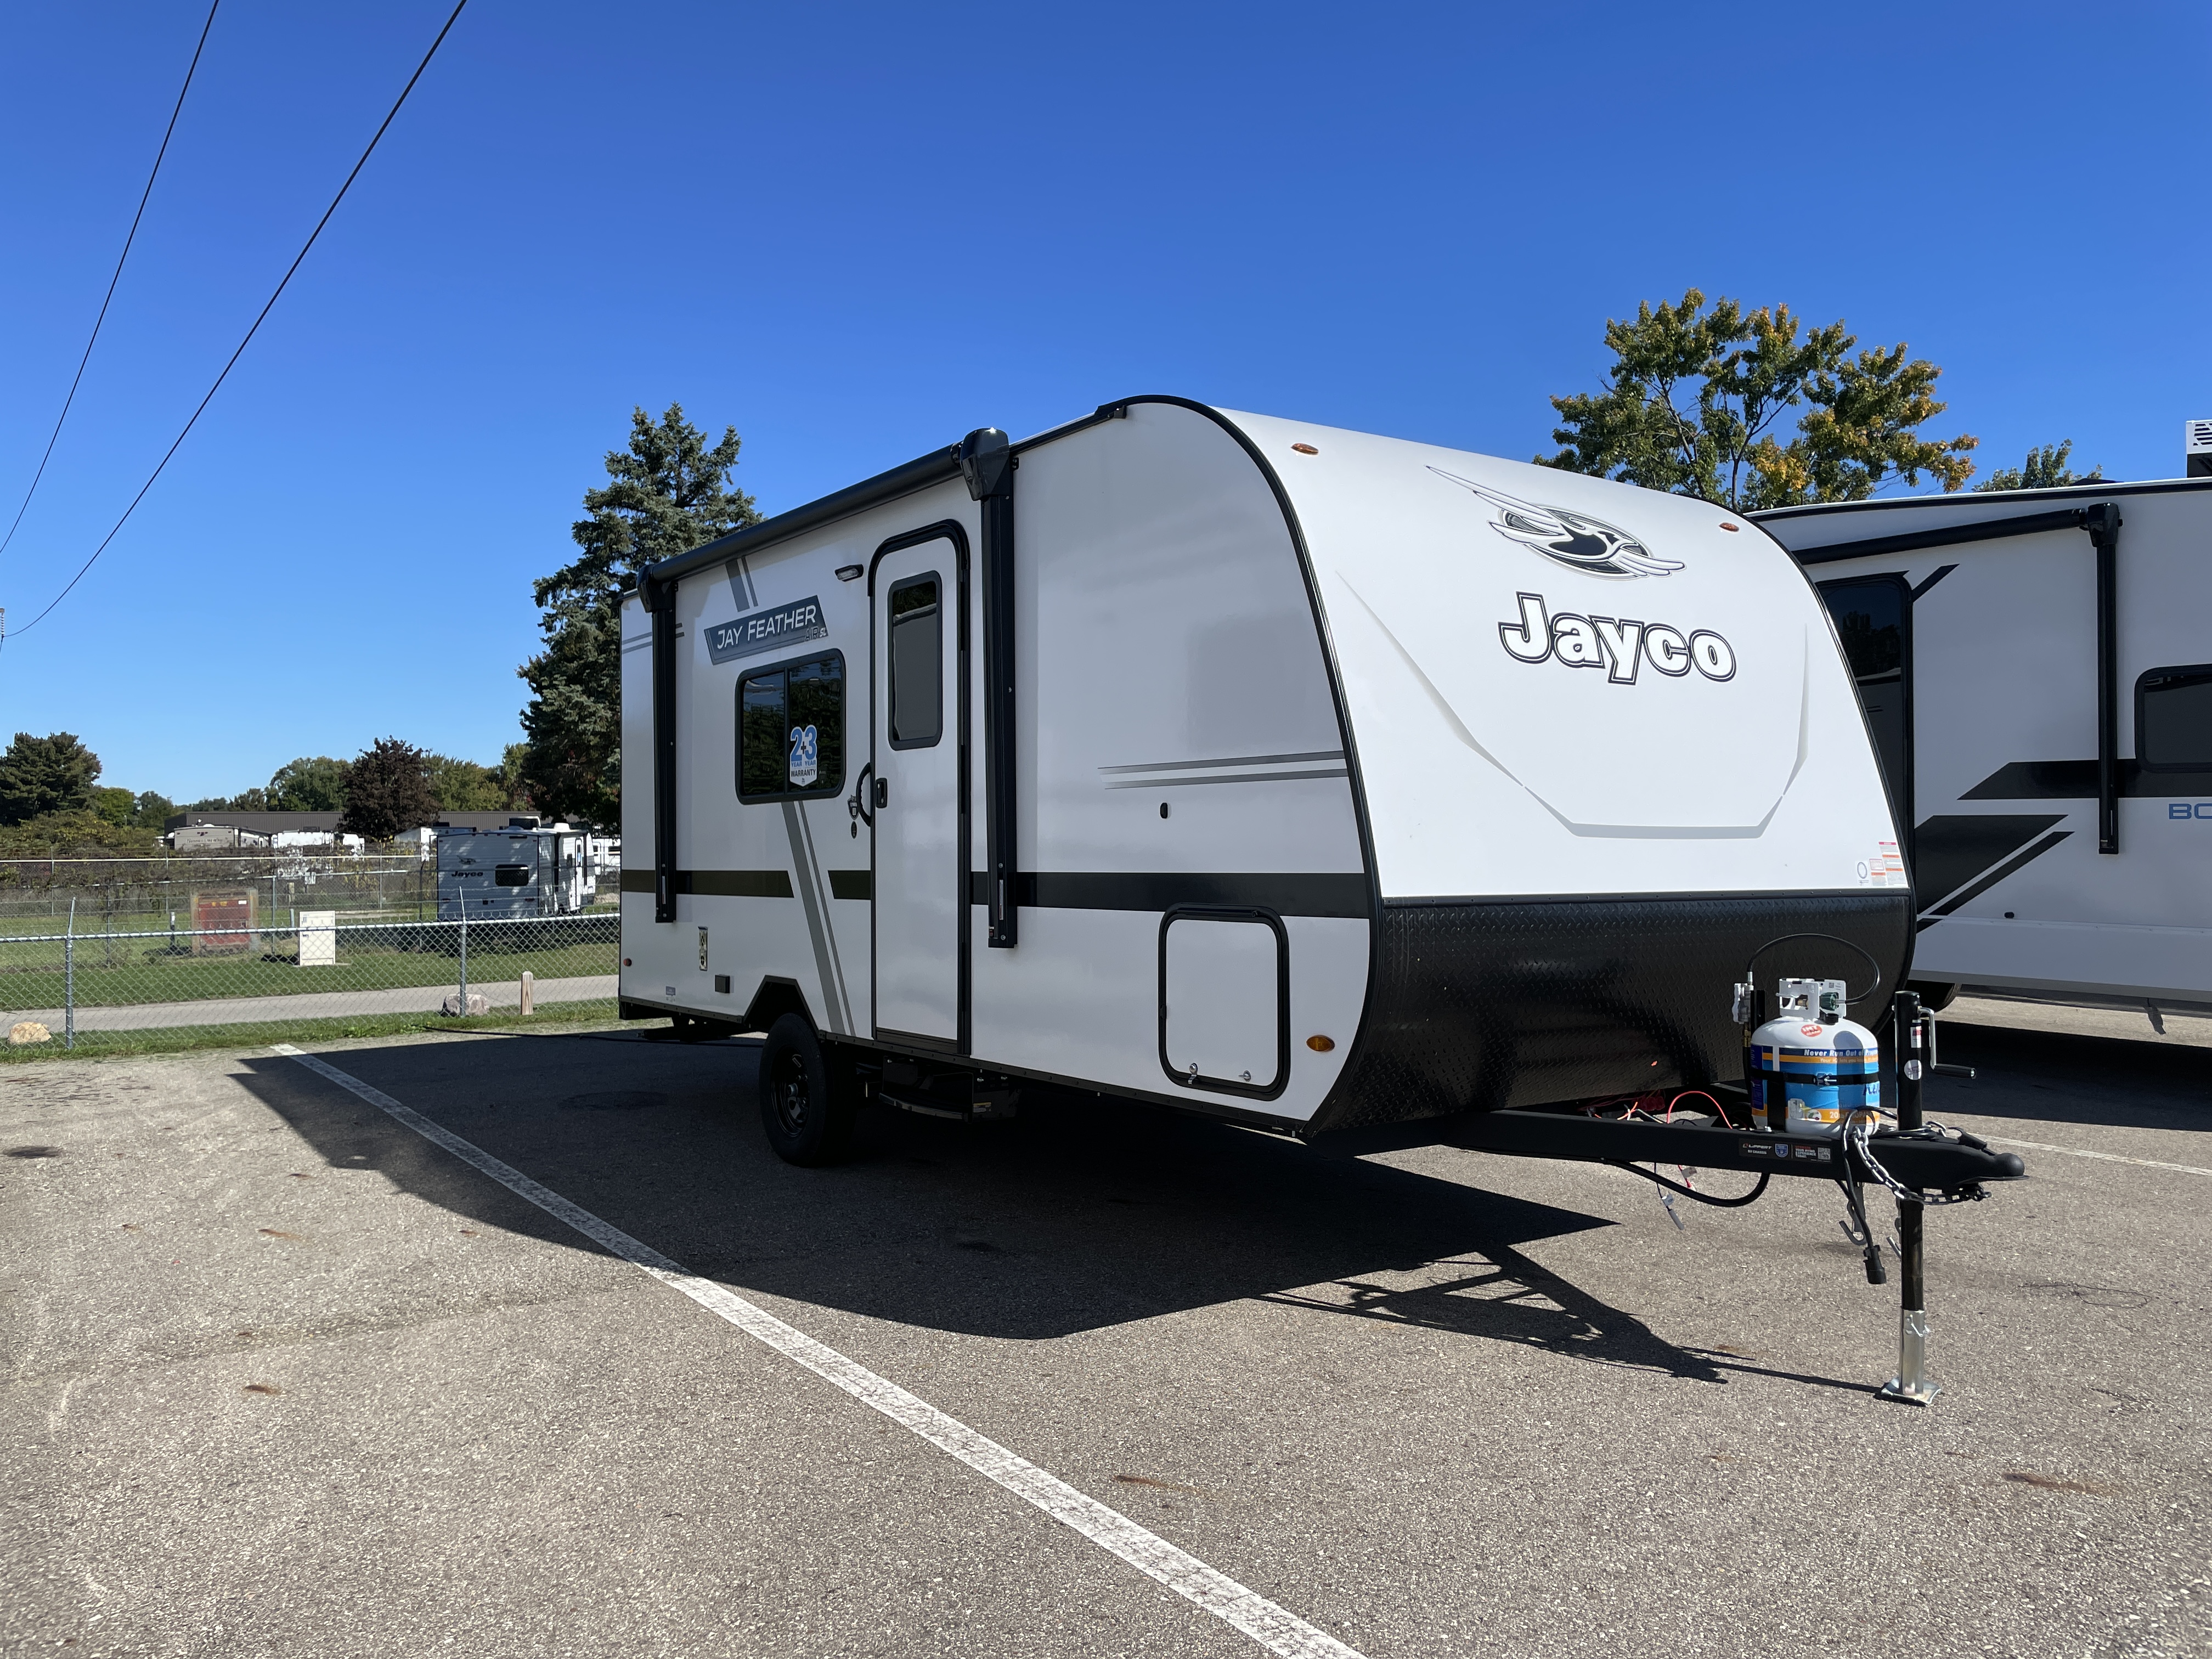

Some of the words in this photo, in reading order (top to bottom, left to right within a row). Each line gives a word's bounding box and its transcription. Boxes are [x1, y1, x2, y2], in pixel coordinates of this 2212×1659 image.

[717, 626, 743, 650] JAY
[747, 605, 816, 641] FEATHER
[805, 626, 819, 641] AIR
[1497, 591, 1737, 686] Jayco
[791, 769, 816, 777] WARRANTY
